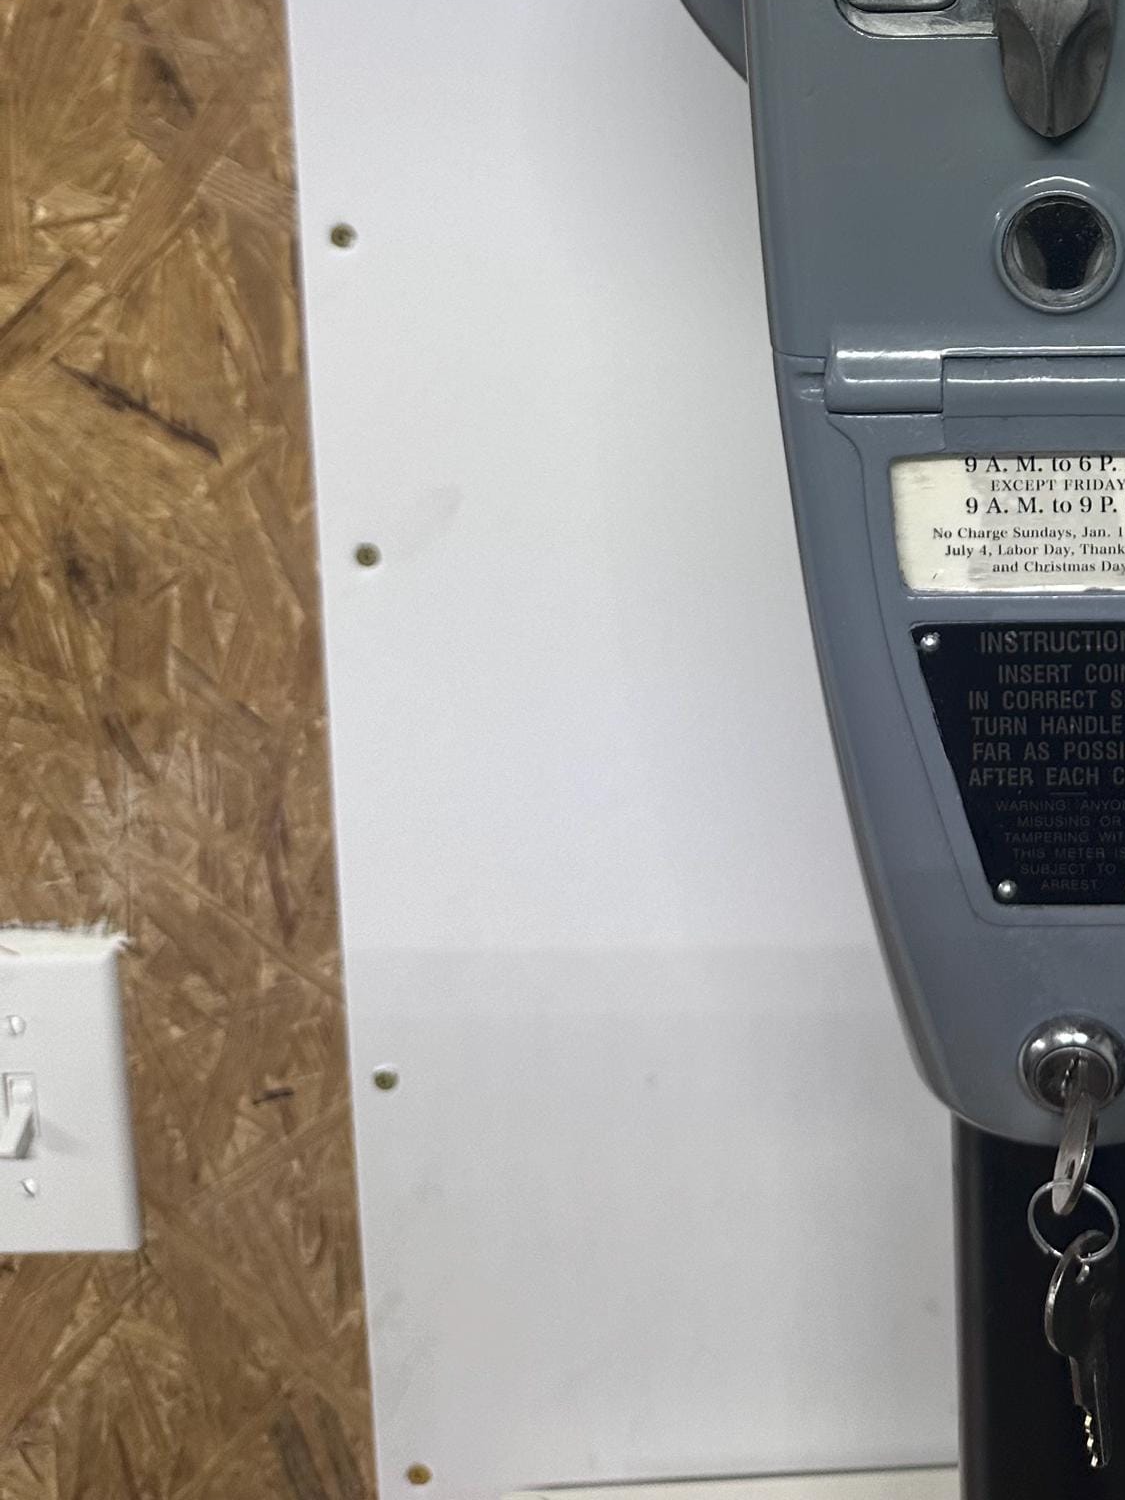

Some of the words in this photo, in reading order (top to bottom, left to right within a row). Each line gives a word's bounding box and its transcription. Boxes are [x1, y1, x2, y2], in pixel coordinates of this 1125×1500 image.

[964, 455, 977, 472] 9
[1052, 456, 1071, 472] to
[1079, 455, 1091, 472] 6
[991, 479, 1056, 491] EXCEPT
[965, 497, 978, 514] 9
[1053, 497, 1072, 513] to
[1079, 496, 1092, 513] 9
[932, 528, 953, 539] No
[957, 527, 1008, 541] Charge
[1013, 527, 1077, 540] Sundays,
[1081, 527, 1111, 538] Jan.
[945, 545, 974, 558] July
[979, 544, 992, 556] 4,
[998, 543, 1039, 555] Labor
[1044, 543, 1075, 557] Day,
[992, 561, 1018, 573] and
[1024, 560, 1096, 573] Christmas
[999, 664, 1072, 683] INSERT
[969, 691, 988, 710] IN
[1003, 690, 1097, 709] CORRECT
[971, 717, 1027, 735] TURN
[1041, 716, 1122, 734] HANDLE
[973, 742, 1011, 761] FAR
[1024, 742, 1050, 760] AS
[969, 768, 1033, 786] AFTER
[1047, 767, 1099, 786] EACH
[1017, 816, 1090, 827] MISUSING
[1100, 816, 1122, 826] OR
[1005, 832, 1089, 843] TAMPERING
[1013, 848, 1045, 859] THIS
[1054, 848, 1105, 858] METER
[1020, 863, 1086, 875] SUBJECT
[1099, 863, 1116, 874] TO
